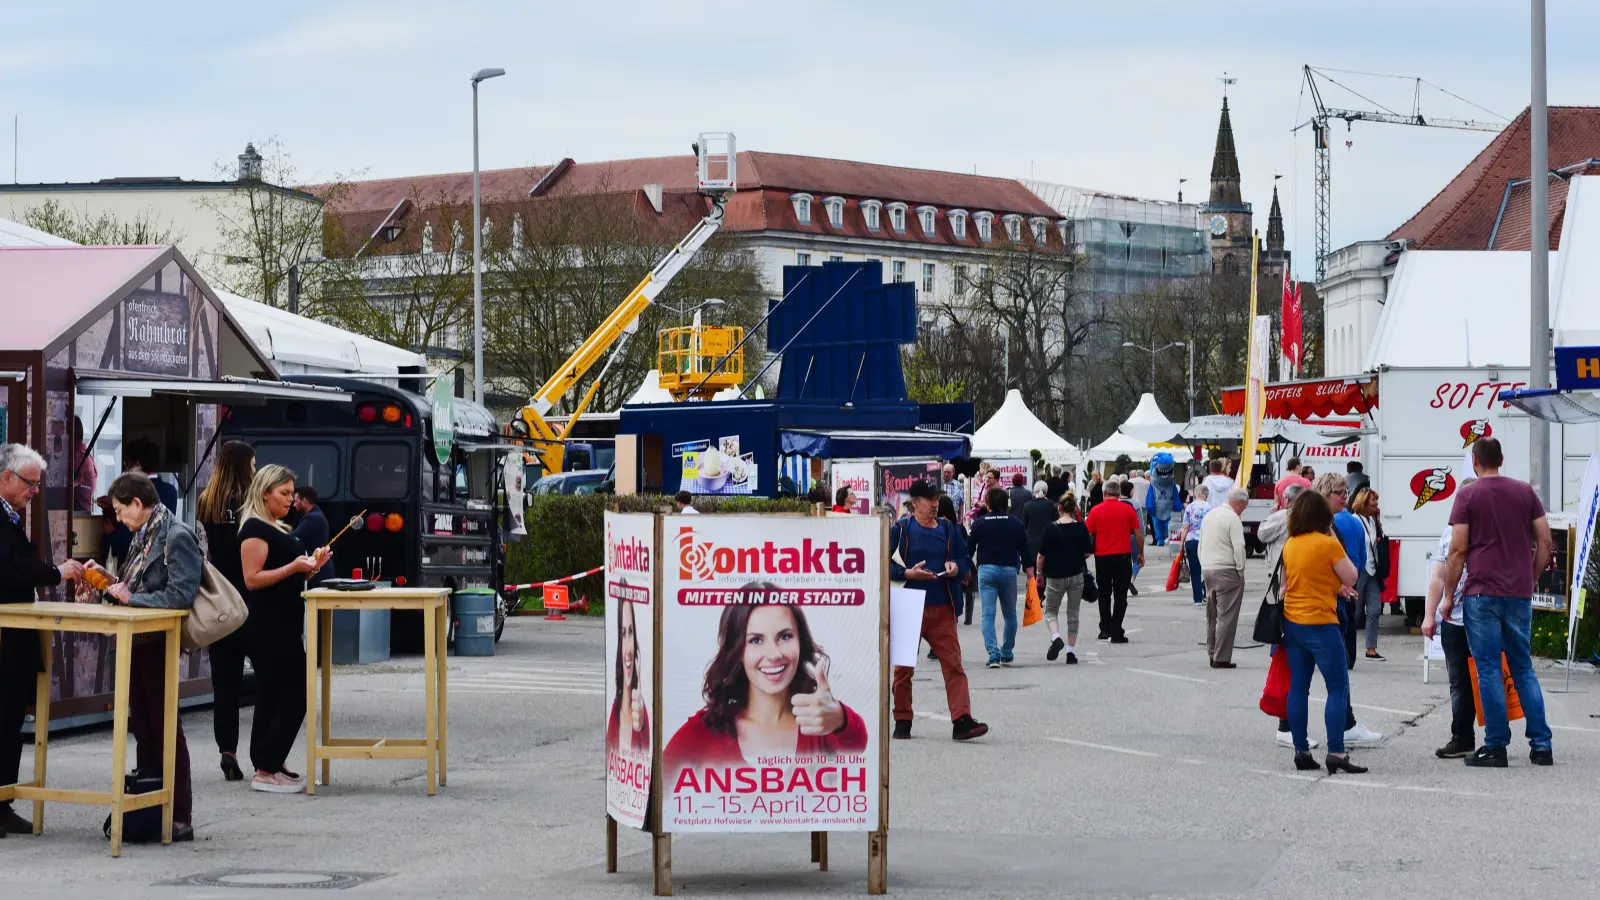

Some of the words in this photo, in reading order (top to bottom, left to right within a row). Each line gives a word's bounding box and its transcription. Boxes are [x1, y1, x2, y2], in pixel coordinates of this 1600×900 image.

[128, 299, 157, 314] ofenfrisch
[128, 316, 187, 350] Rahmbrot
[128, 350, 138, 360] aus
[138, 350, 150, 361] dem
[150, 349, 188, 365] Steinbackofen
[1315, 383, 1348, 396] SLUSH
[785, 576, 816, 584] erleben
[834, 577, 863, 586] sparen
[685, 591, 747, 605] MITTEN
[748, 591, 765, 605] IN
[769, 591, 799, 605] DER
[803, 591, 856, 605] STADT!
[757, 755, 792, 766] täglich
[848, 755, 867, 765] Uhr
[609, 752, 651, 793] ANSBACH
[673, 767, 866, 793] ANSBACH
[751, 795, 807, 817] April
[812, 795, 868, 814] 2018
[673, 817, 712, 826] Festplatz
[714, 817, 752, 825] Hofwiese
[760, 817, 867, 825] www.kontakta-ansbach.de
